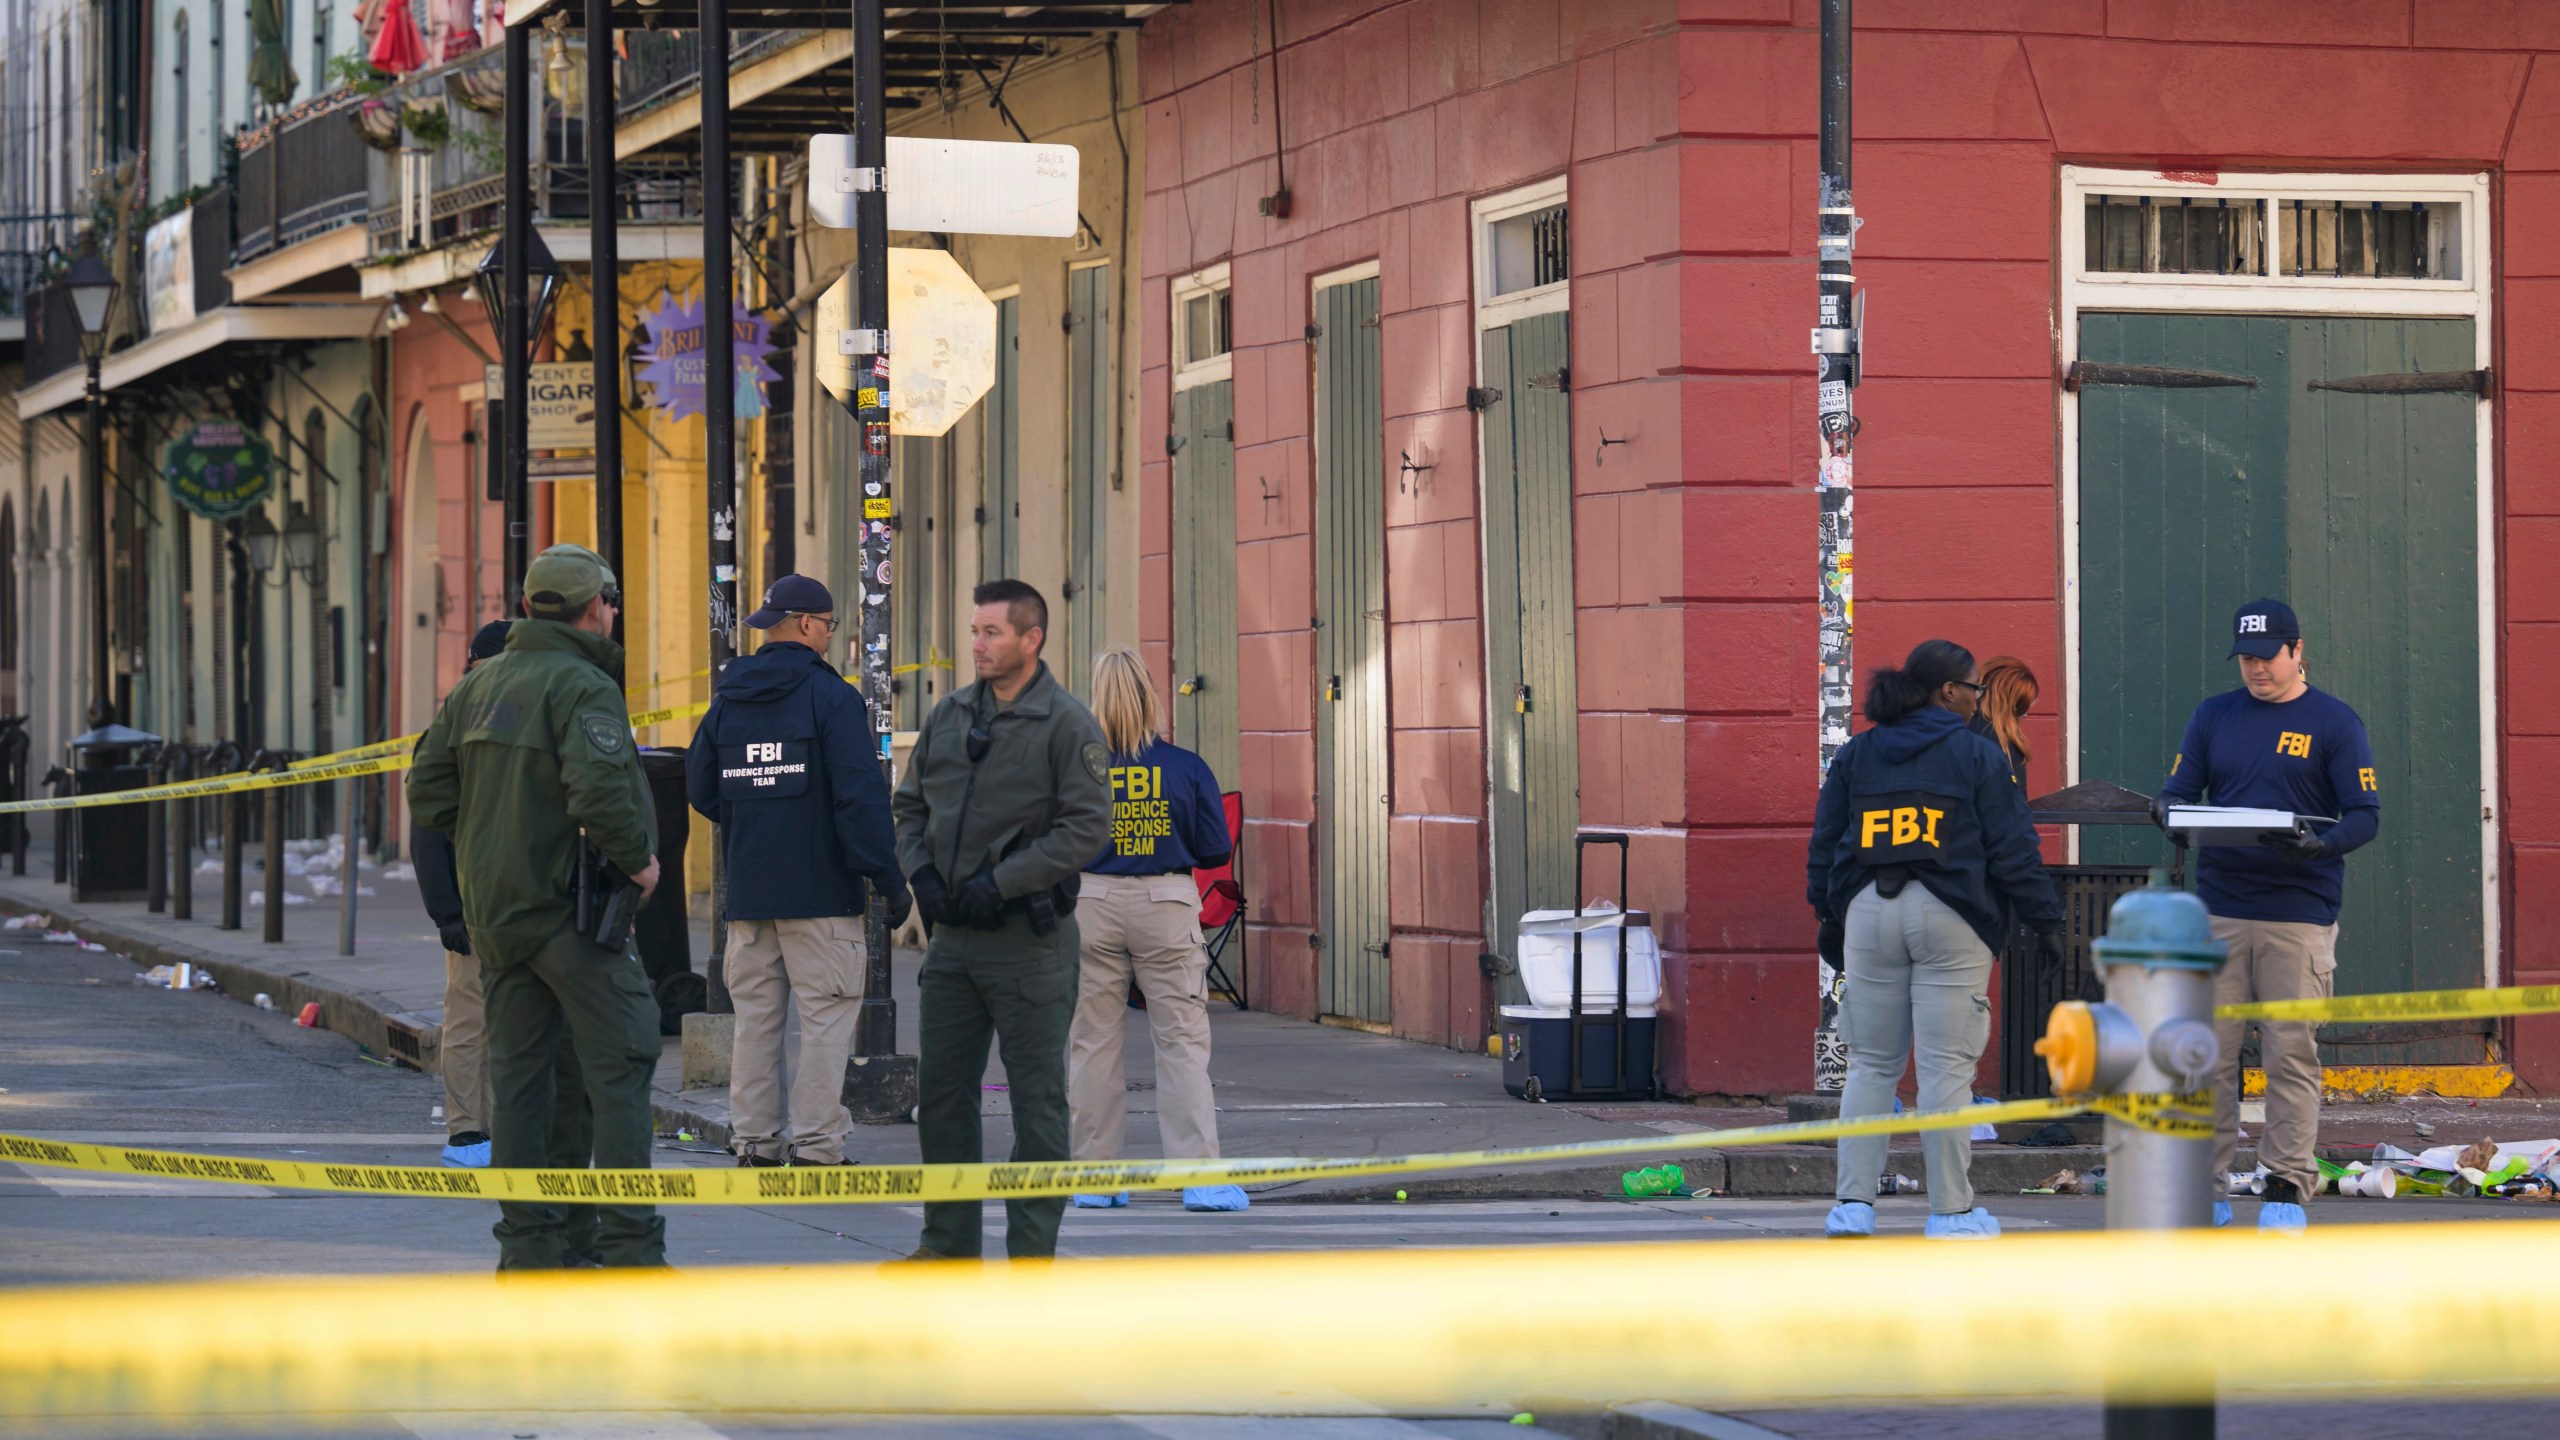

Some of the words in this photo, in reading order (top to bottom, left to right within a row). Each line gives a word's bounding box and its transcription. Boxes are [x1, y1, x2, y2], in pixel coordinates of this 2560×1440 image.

[530, 403, 578, 416] SHOP
[2238, 614, 2267, 633] FBI
[647, 709, 673, 724] CROSS
[746, 742, 783, 763] FBI
[2275, 730, 2313, 759] FBI
[270, 773, 299, 785] CRIME
[298, 769, 325, 782] SCENE
[325, 767, 338, 778] DO
[337, 765, 354, 776] NOT
[354, 760, 381, 773] CROSS
[722, 767, 763, 778] EVIDENCE
[763, 763, 805, 775] RESPONSE
[752, 776, 776, 787] TEAM
[1109, 765, 1162, 801] FBI
[1861, 806, 1945, 849] FBI
[1114, 837, 1155, 856] TEAM
[124, 1151, 166, 1173] CROSS
[160, 1155, 188, 1174] NOT
[183, 1156, 205, 1176] DO
[199, 1158, 240, 1180] SCENE
[234, 1161, 276, 1182] CRIME
[325, 1166, 366, 1188] CROSS
[363, 1168, 390, 1189] NOT
[386, 1169, 408, 1190] DO
[403, 1170, 444, 1192] SCENE
[440, 1171, 481, 1194] CRIME
[536, 1173, 576, 1196] CROSS
[576, 1173, 602, 1197] NOT
[601, 1173, 620, 1197] DO
[619, 1173, 657, 1197] SCENE
[658, 1173, 696, 1197] CRIME
[758, 1171, 796, 1197] CROSS
[799, 1171, 822, 1196] NOT
[825, 1171, 841, 1196] DO
[844, 1170, 882, 1195] SCENE
[884, 1169, 923, 1194] CRIME
[987, 1166, 1030, 1191] CROSS
[1029, 1166, 1058, 1189] NOT
[1056, 1165, 1079, 1188] DO
